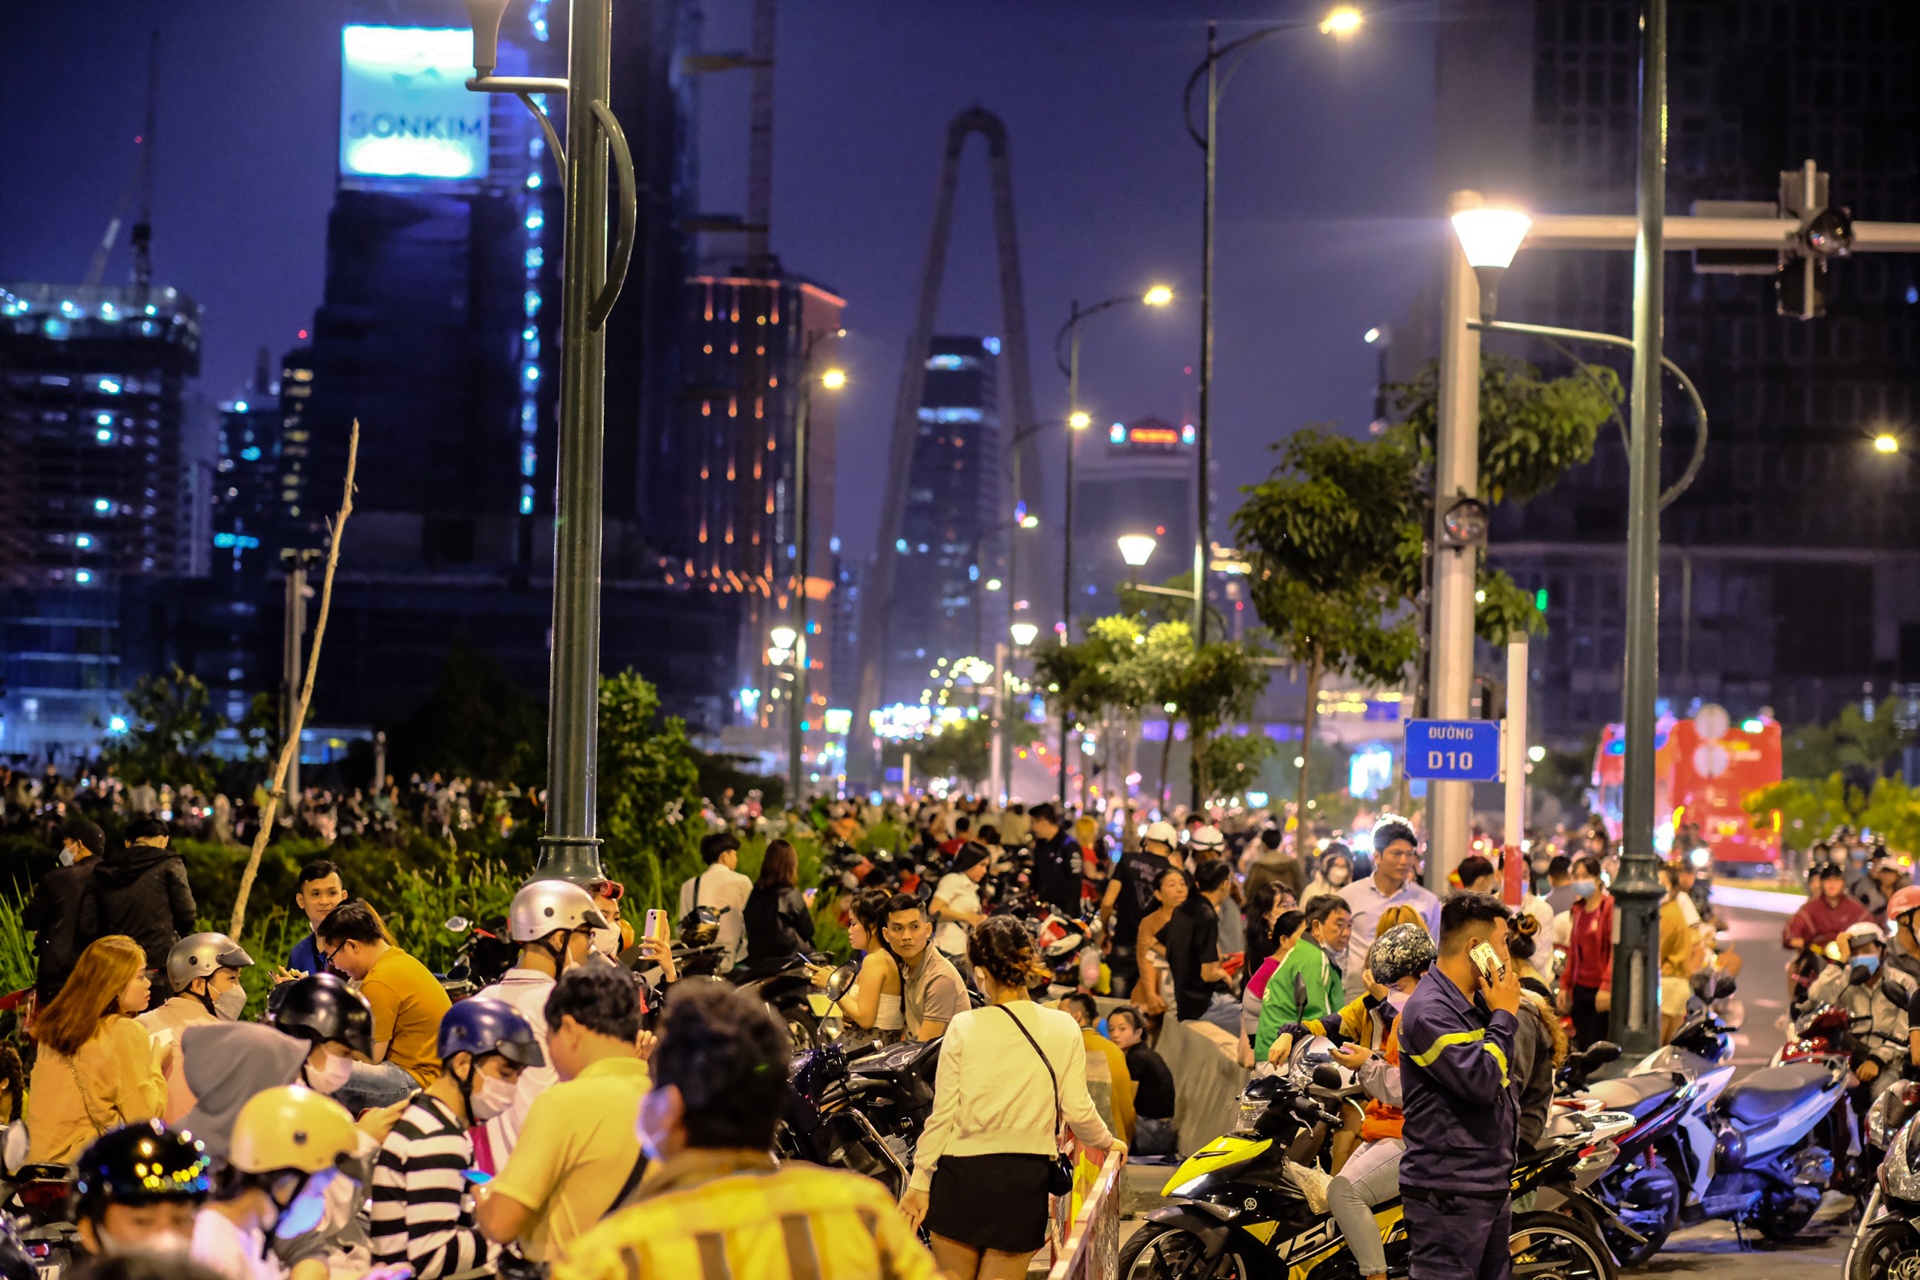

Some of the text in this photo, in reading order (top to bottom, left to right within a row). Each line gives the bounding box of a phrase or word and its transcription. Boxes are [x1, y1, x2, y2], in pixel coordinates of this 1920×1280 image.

[349, 111, 482, 140] SONKIM
[1428, 724, 1474, 740] ĐƯỜNG
[1428, 751, 1473, 770] D10
